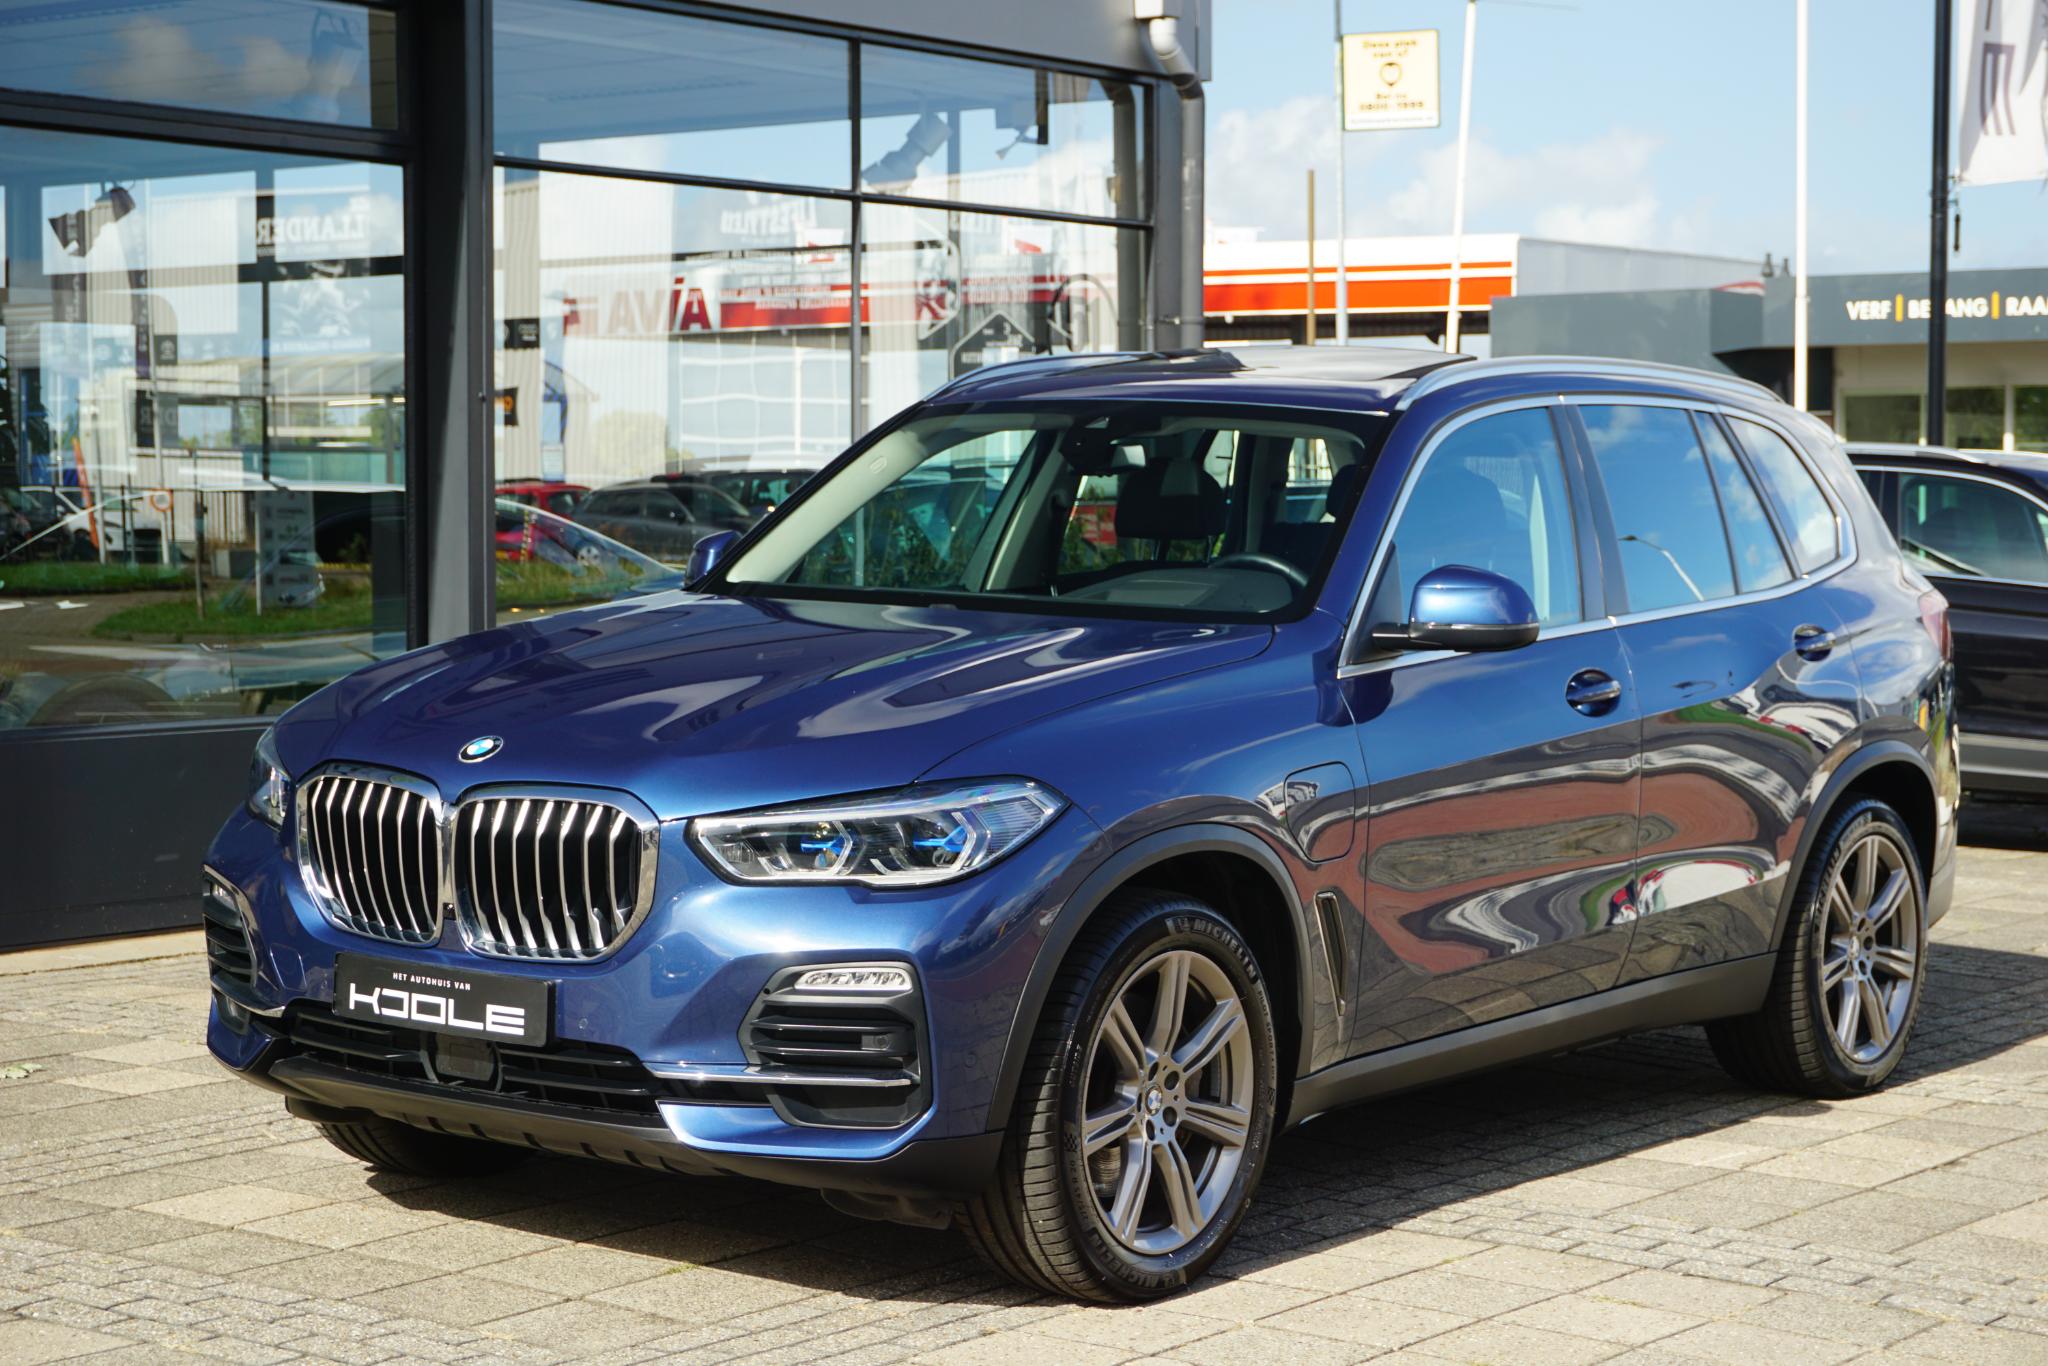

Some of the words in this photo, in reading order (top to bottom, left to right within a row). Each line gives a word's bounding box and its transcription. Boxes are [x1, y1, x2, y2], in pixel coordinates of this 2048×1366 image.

[1846, 300, 1891, 320] VERF
[1908, 297, 1989, 319] BEANG
[2005, 296, 2048, 316] RAA
[1194, 922, 1257, 981] MICHELIN
[392, 972, 407, 981] HET
[410, 975, 451, 988] AUTOHUIS
[454, 981, 471, 991] VAN
[349, 982, 525, 1036] KOOLE
